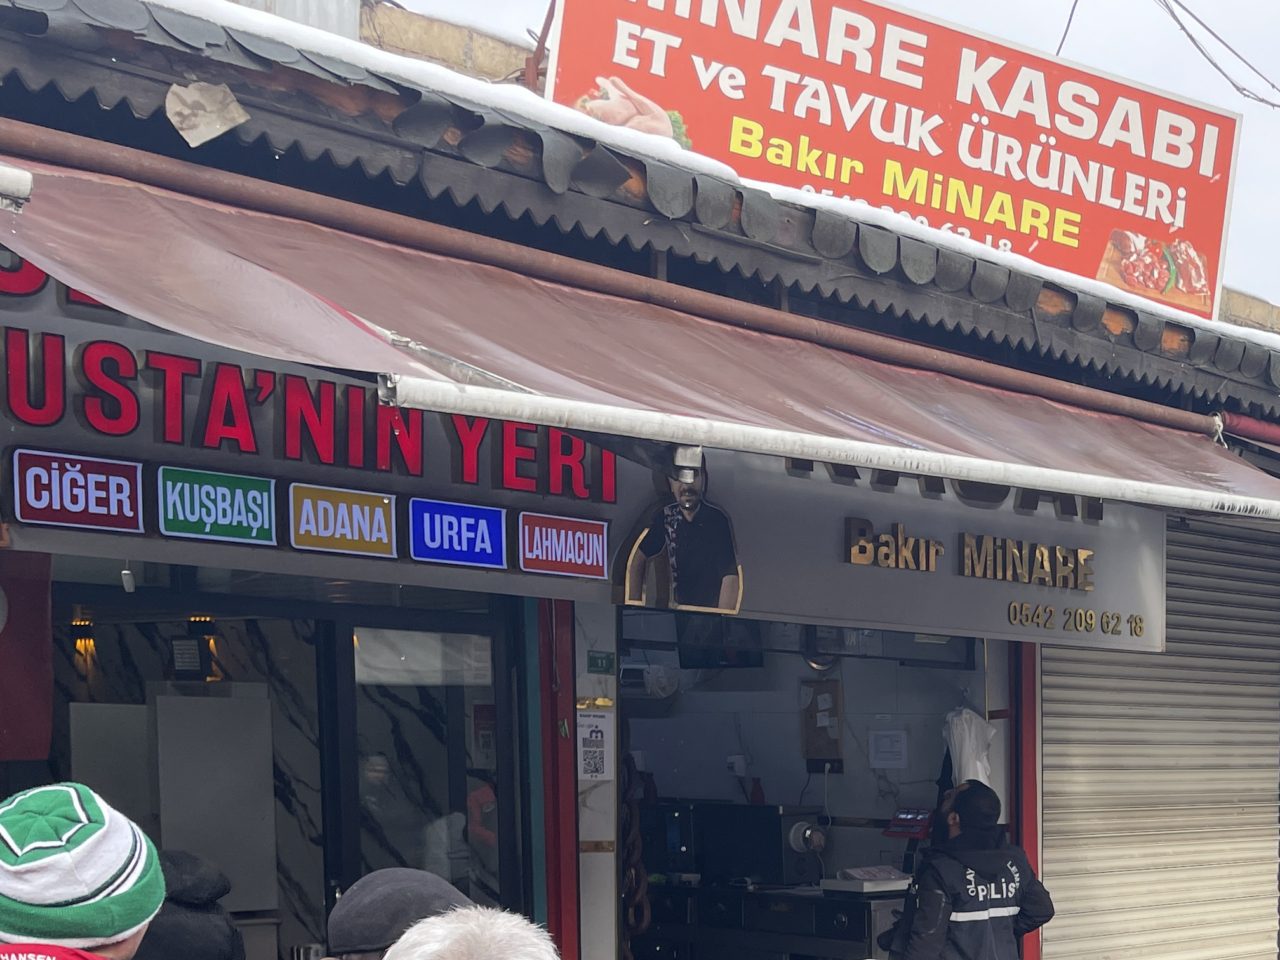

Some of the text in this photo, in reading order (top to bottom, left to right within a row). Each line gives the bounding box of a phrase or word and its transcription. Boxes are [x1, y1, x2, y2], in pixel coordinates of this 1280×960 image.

[613, 19, 682, 77] ET
[691, 54, 746, 100] ve
[761, 66, 944, 158] TAVUK
[957, 48, 1220, 178] KASABI
[729, 116, 865, 184] Bakır
[25, 462, 134, 519] CİĞER
[165, 481, 270, 536] KUŞBAŞI
[299, 498, 390, 544] ADANA
[423, 512, 493, 556] URFA
[525, 525, 603, 567] LAHMACUN
[846, 517, 944, 571] Bakır
[1008, 601, 1145, 637] 0542 209 62 18
[966, 868, 976, 896] OLAY
[977, 878, 1015, 901] PLİS
